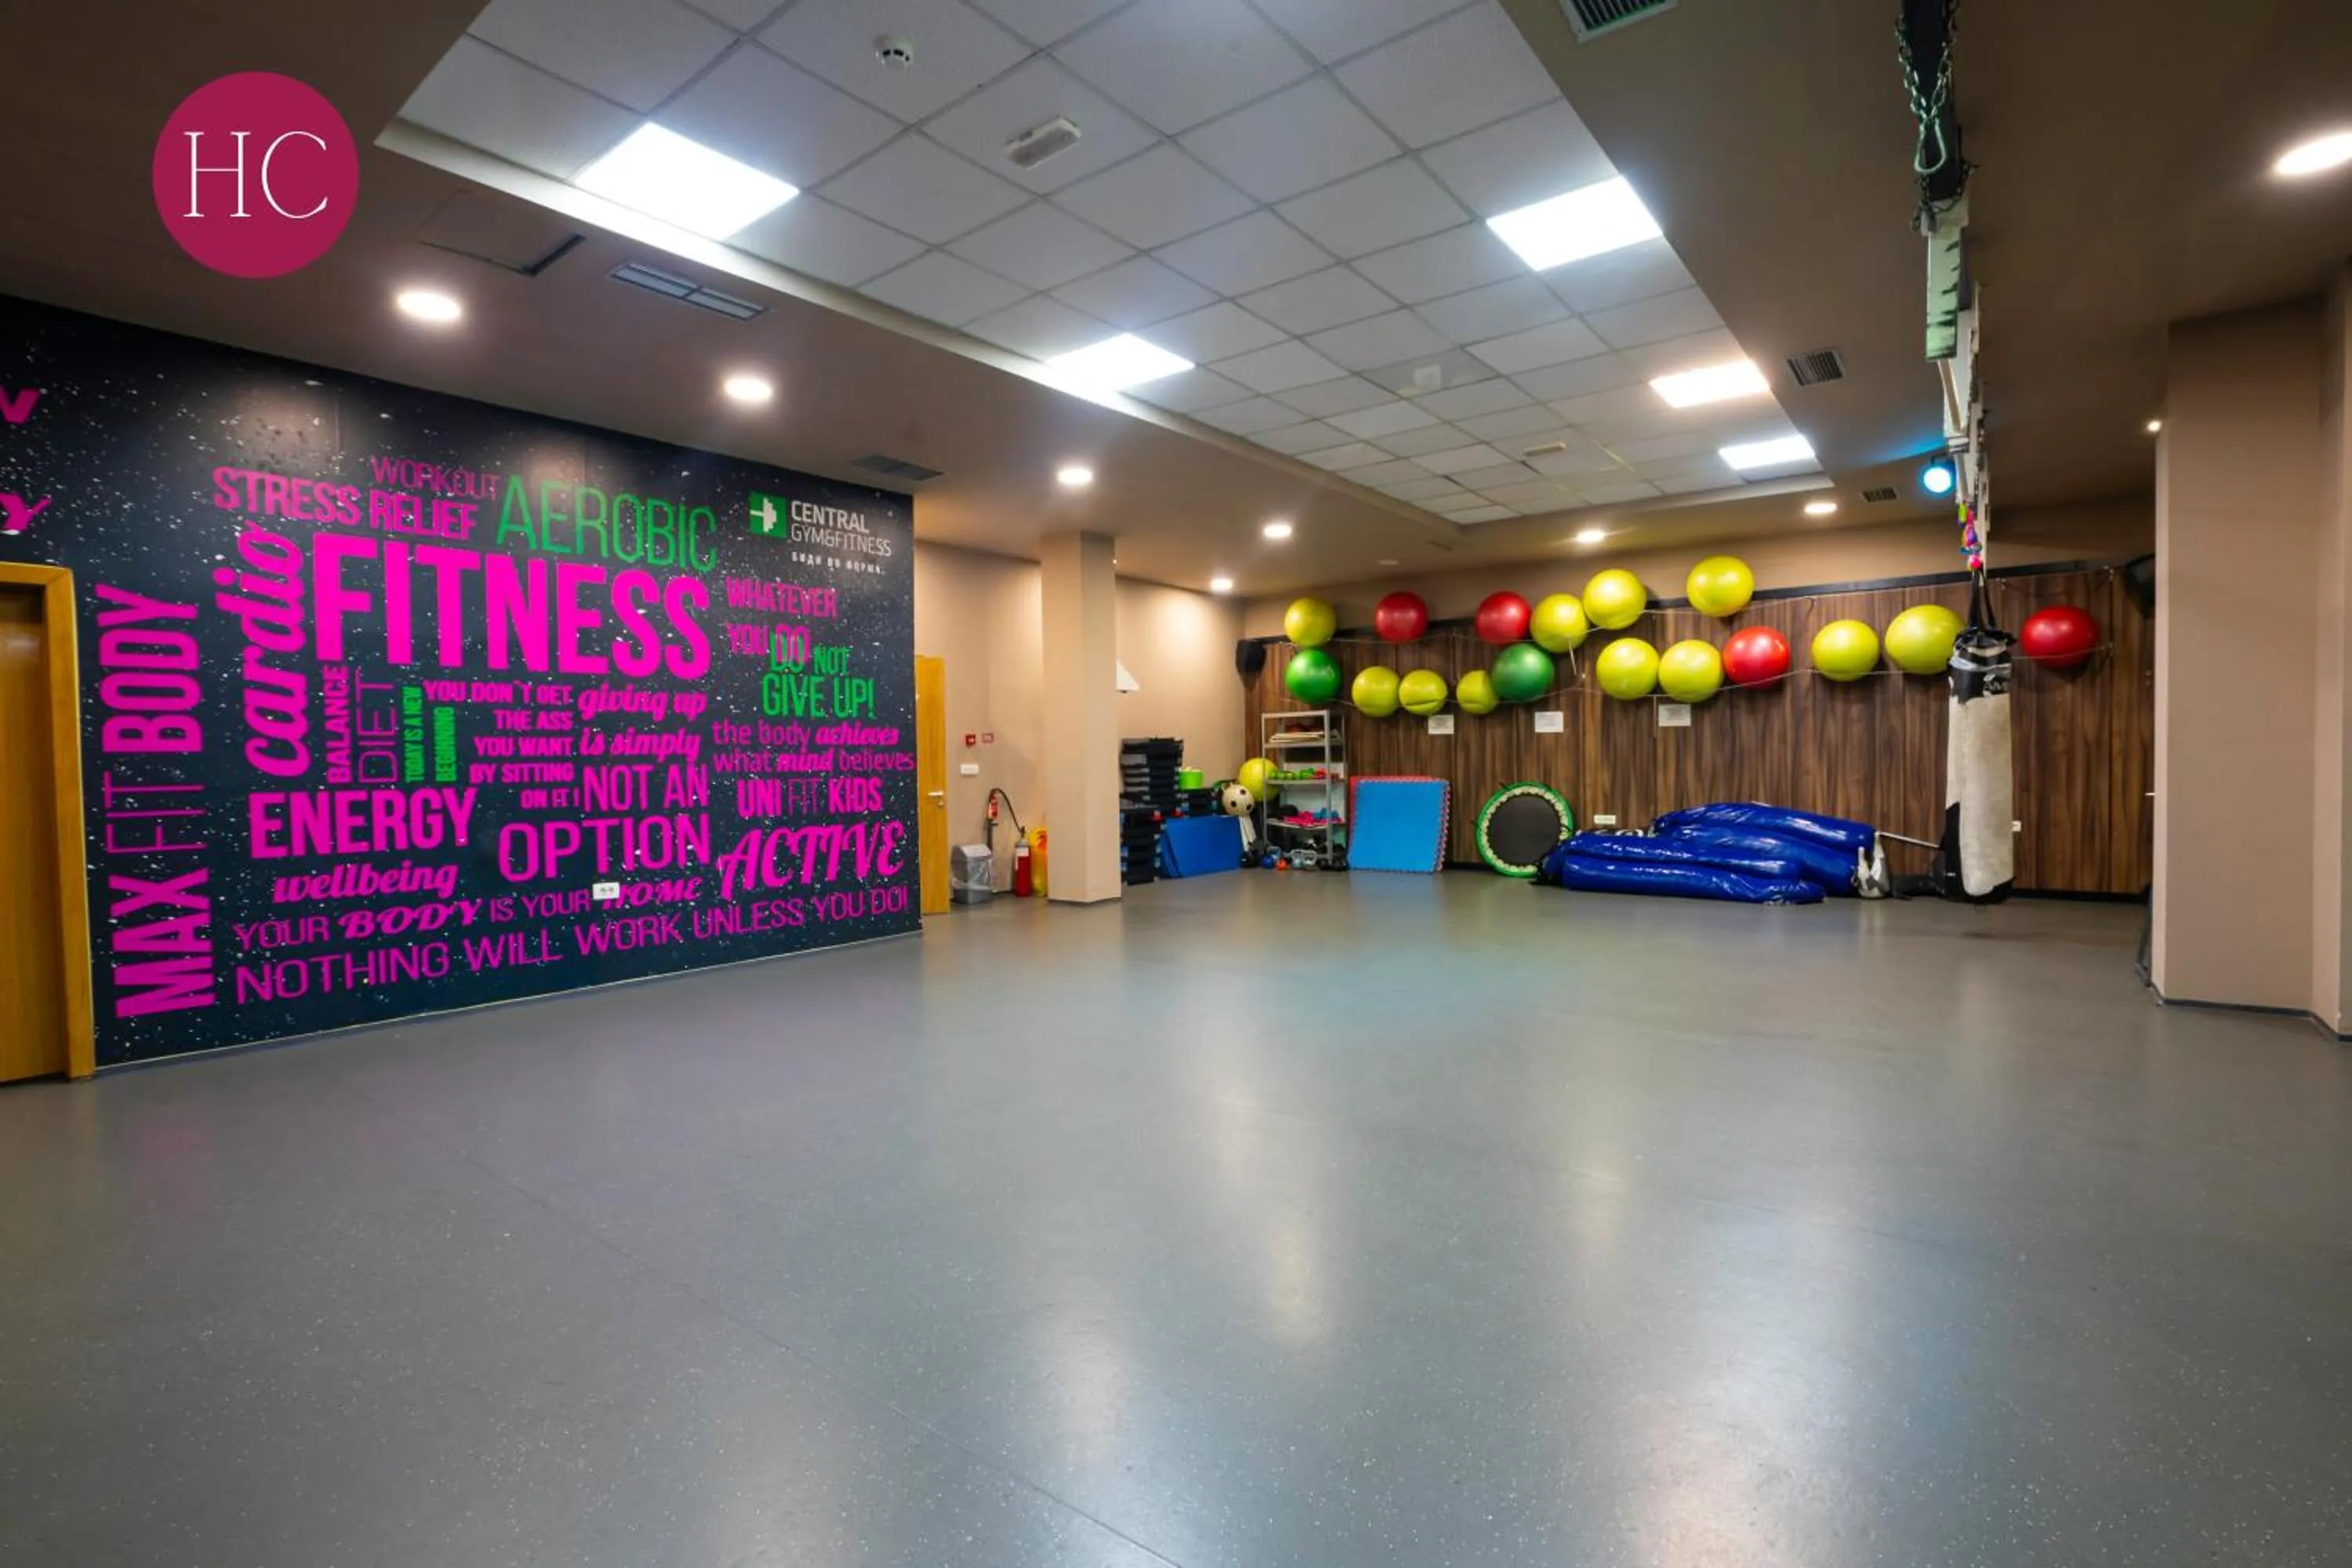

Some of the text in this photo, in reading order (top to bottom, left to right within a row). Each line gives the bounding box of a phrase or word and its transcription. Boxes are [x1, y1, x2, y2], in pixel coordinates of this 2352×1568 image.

[371, 454, 500, 501] WORKOUT
[213, 468, 477, 541] STRESS RELIEF
[496, 477, 717, 573] AEROBIC
[790, 499, 870, 535] CENTRAL
[791, 522, 892, 557] GYM&FITNESS
[312, 531, 711, 681] FITNESS
[725, 575, 838, 619] WHATEVER
[213, 521, 311, 777] cardio
[727, 623, 768, 655] YOU
[812, 645, 851, 677] NOT
[423, 680, 467, 702] YOU
[535, 684, 572, 706] GET
[577, 683, 707, 721] giving up
[761, 671, 875, 719] GIVE UP!
[322, 665, 352, 783] BALANCE
[355, 669, 398, 783] DIET
[494, 709, 573, 731] THE ASS
[712, 718, 899, 753] the body achieves
[474, 736, 574, 757] YOU WANT
[579, 727, 702, 764] is simply
[714, 746, 915, 772] what mind believes
[470, 762, 575, 785] BY SITTING
[583, 761, 709, 812] NOT AN
[95, 584, 216, 1018] MAX FIT BODY
[521, 789, 547, 809] ON
[737, 776, 883, 818] UNI FIT KIDS
[249, 786, 477, 858] ENERGY
[499, 811, 710, 884] OPTION
[715, 820, 905, 903] ACTIVE
[273, 860, 459, 905] wellbeing
[234, 916, 329, 949] YOUR
[337, 897, 484, 941] BODY
[490, 898, 514, 921] IS
[522, 891, 590, 916] YOUR
[236, 941, 448, 1004] NOTHING
[462, 927, 564, 972] WILL
[572, 909, 681, 954] WORK
[691, 896, 804, 938] UNLESS
[812, 888, 865, 921] YOU
